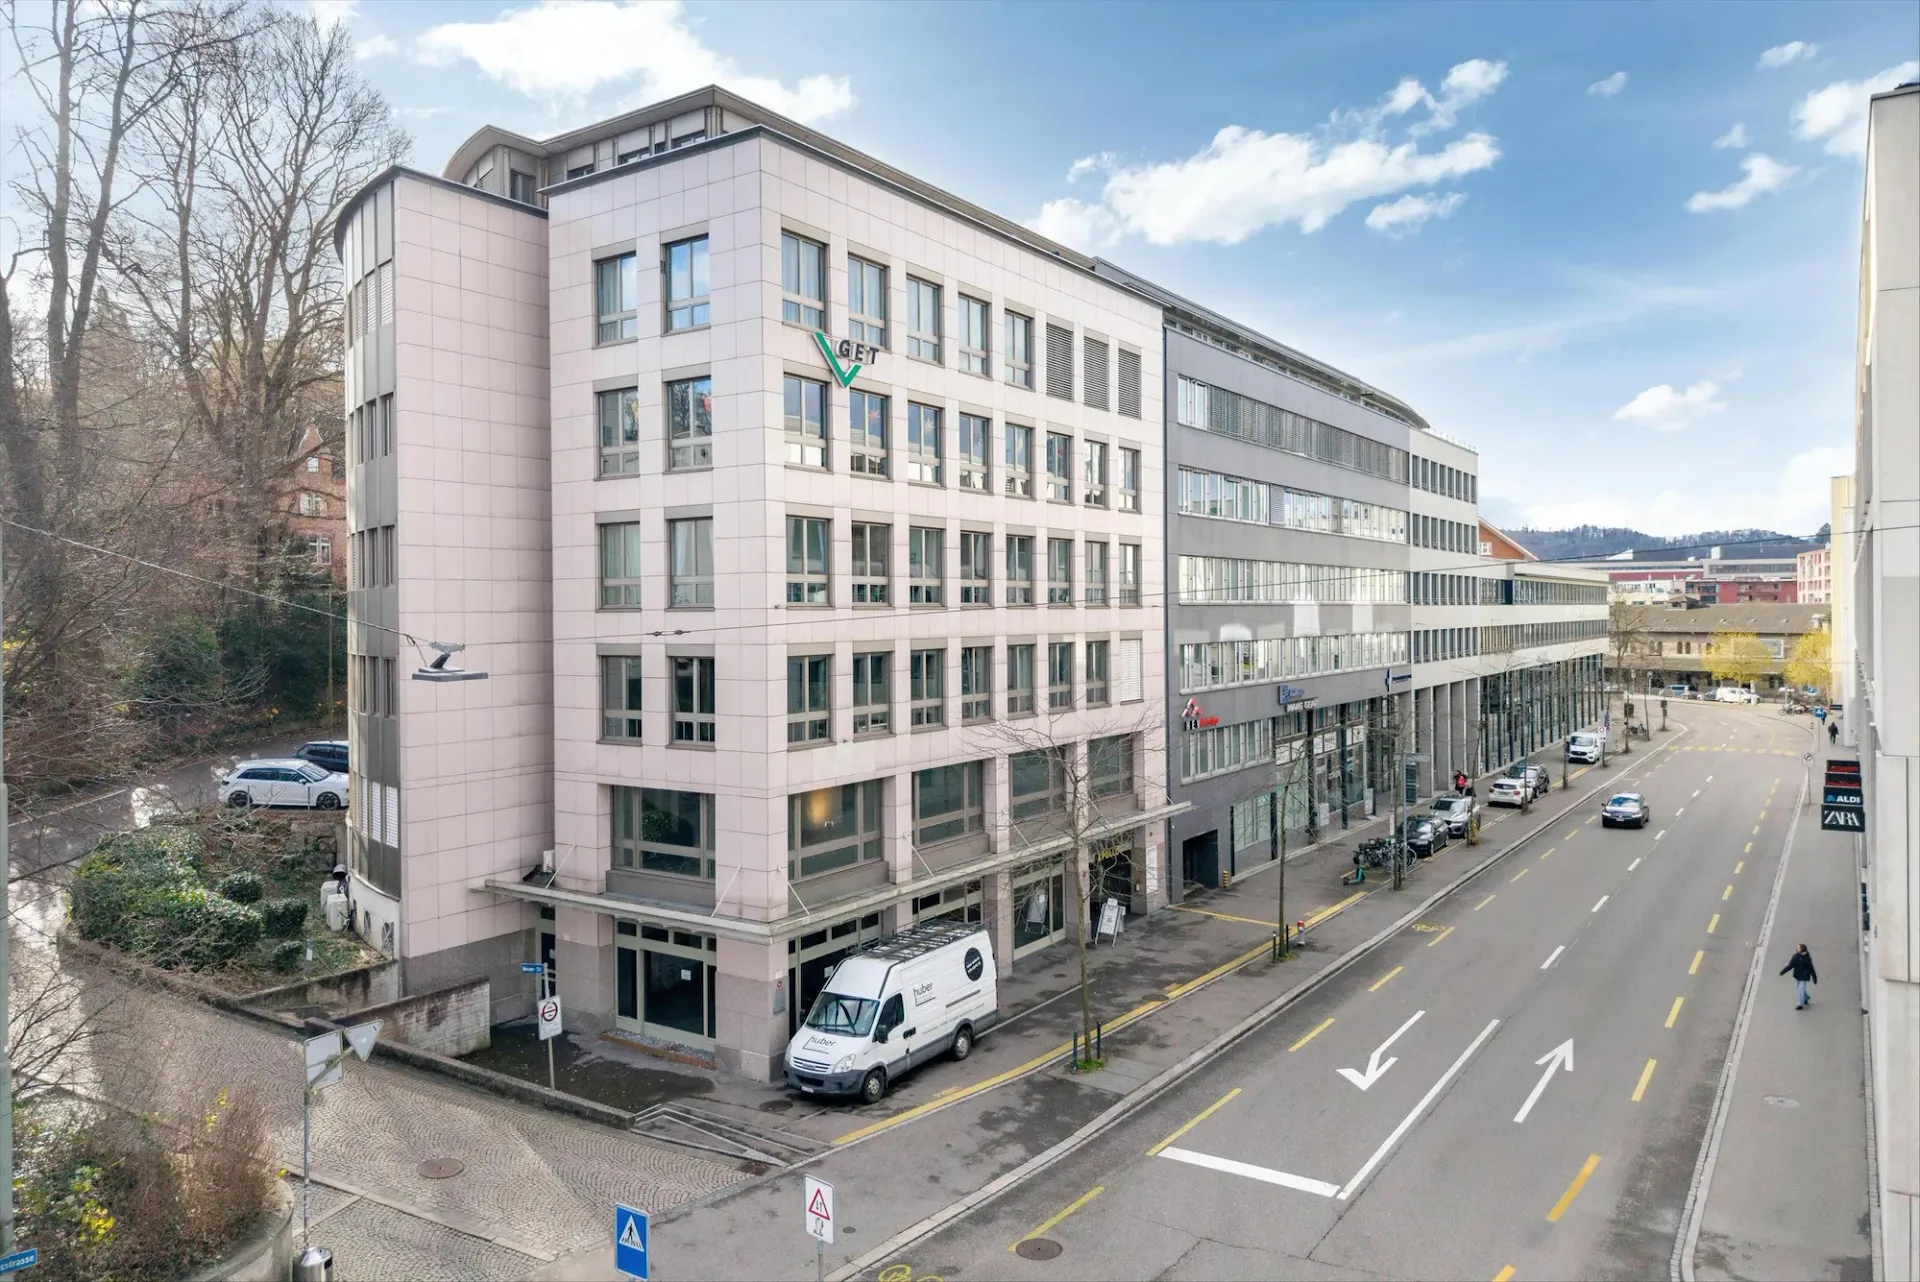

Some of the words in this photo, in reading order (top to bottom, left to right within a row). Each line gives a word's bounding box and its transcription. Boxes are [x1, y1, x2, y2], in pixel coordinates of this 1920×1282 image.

[1836, 795, 1861, 804] ALDI
[1824, 810, 1861, 827] ZARA
[912, 982, 933, 998] huber
[808, 1034, 837, 1048] huber
